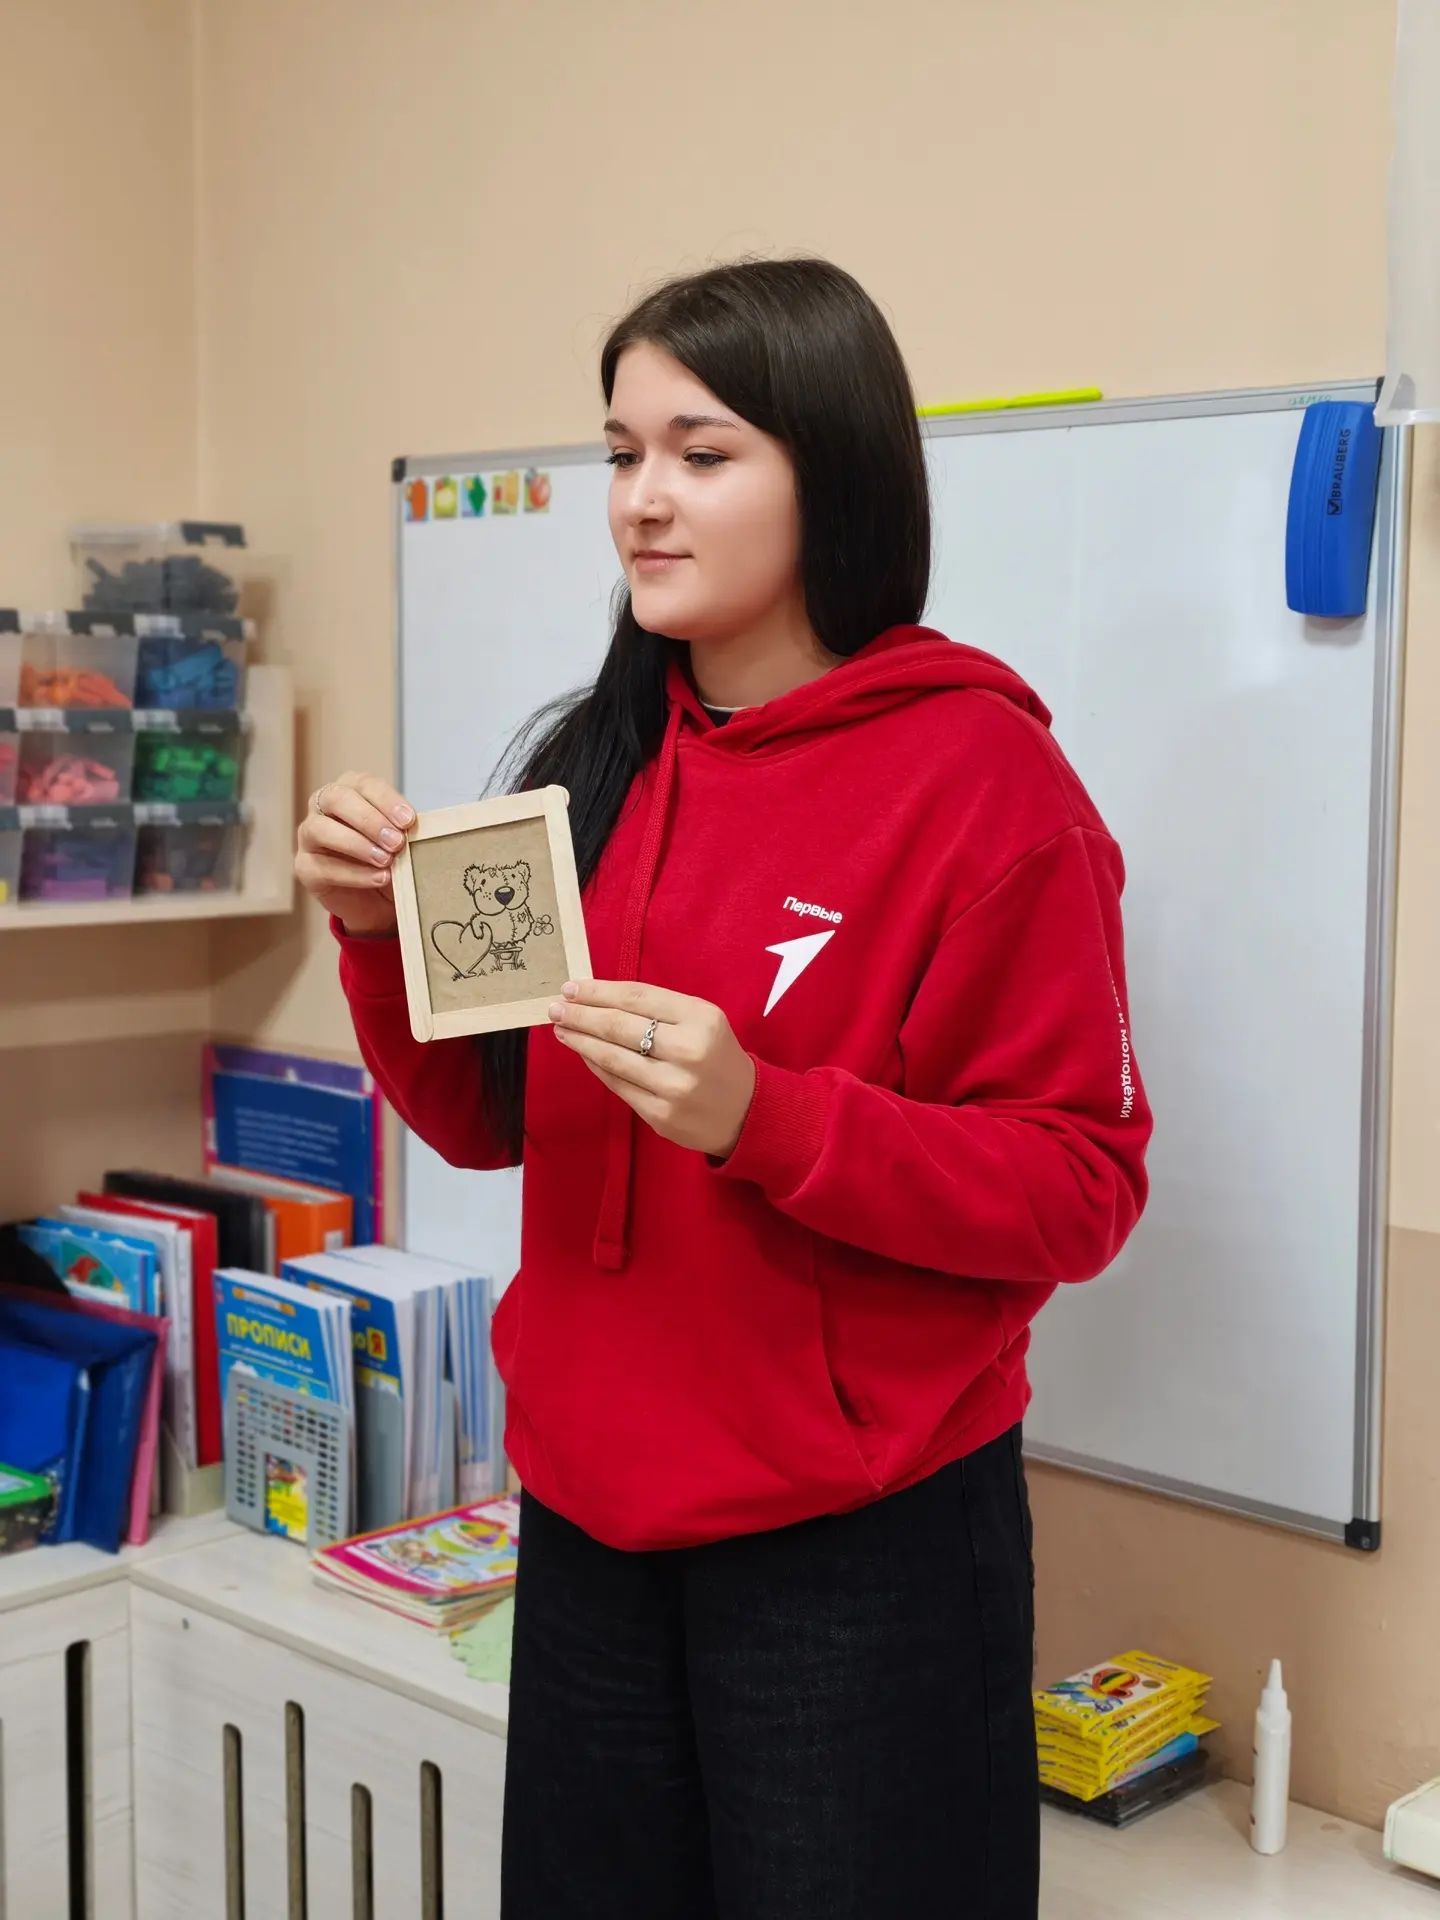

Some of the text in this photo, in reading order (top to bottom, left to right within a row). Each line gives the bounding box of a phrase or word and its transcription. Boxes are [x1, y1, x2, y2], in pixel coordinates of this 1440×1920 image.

[1331, 428, 1351, 498] BRAUBERG
[783, 896, 843, 924] Первые
[1120, 1029, 1136, 1118] молодёжи
[226, 1311, 312, 1361] ПРОПИСИ
